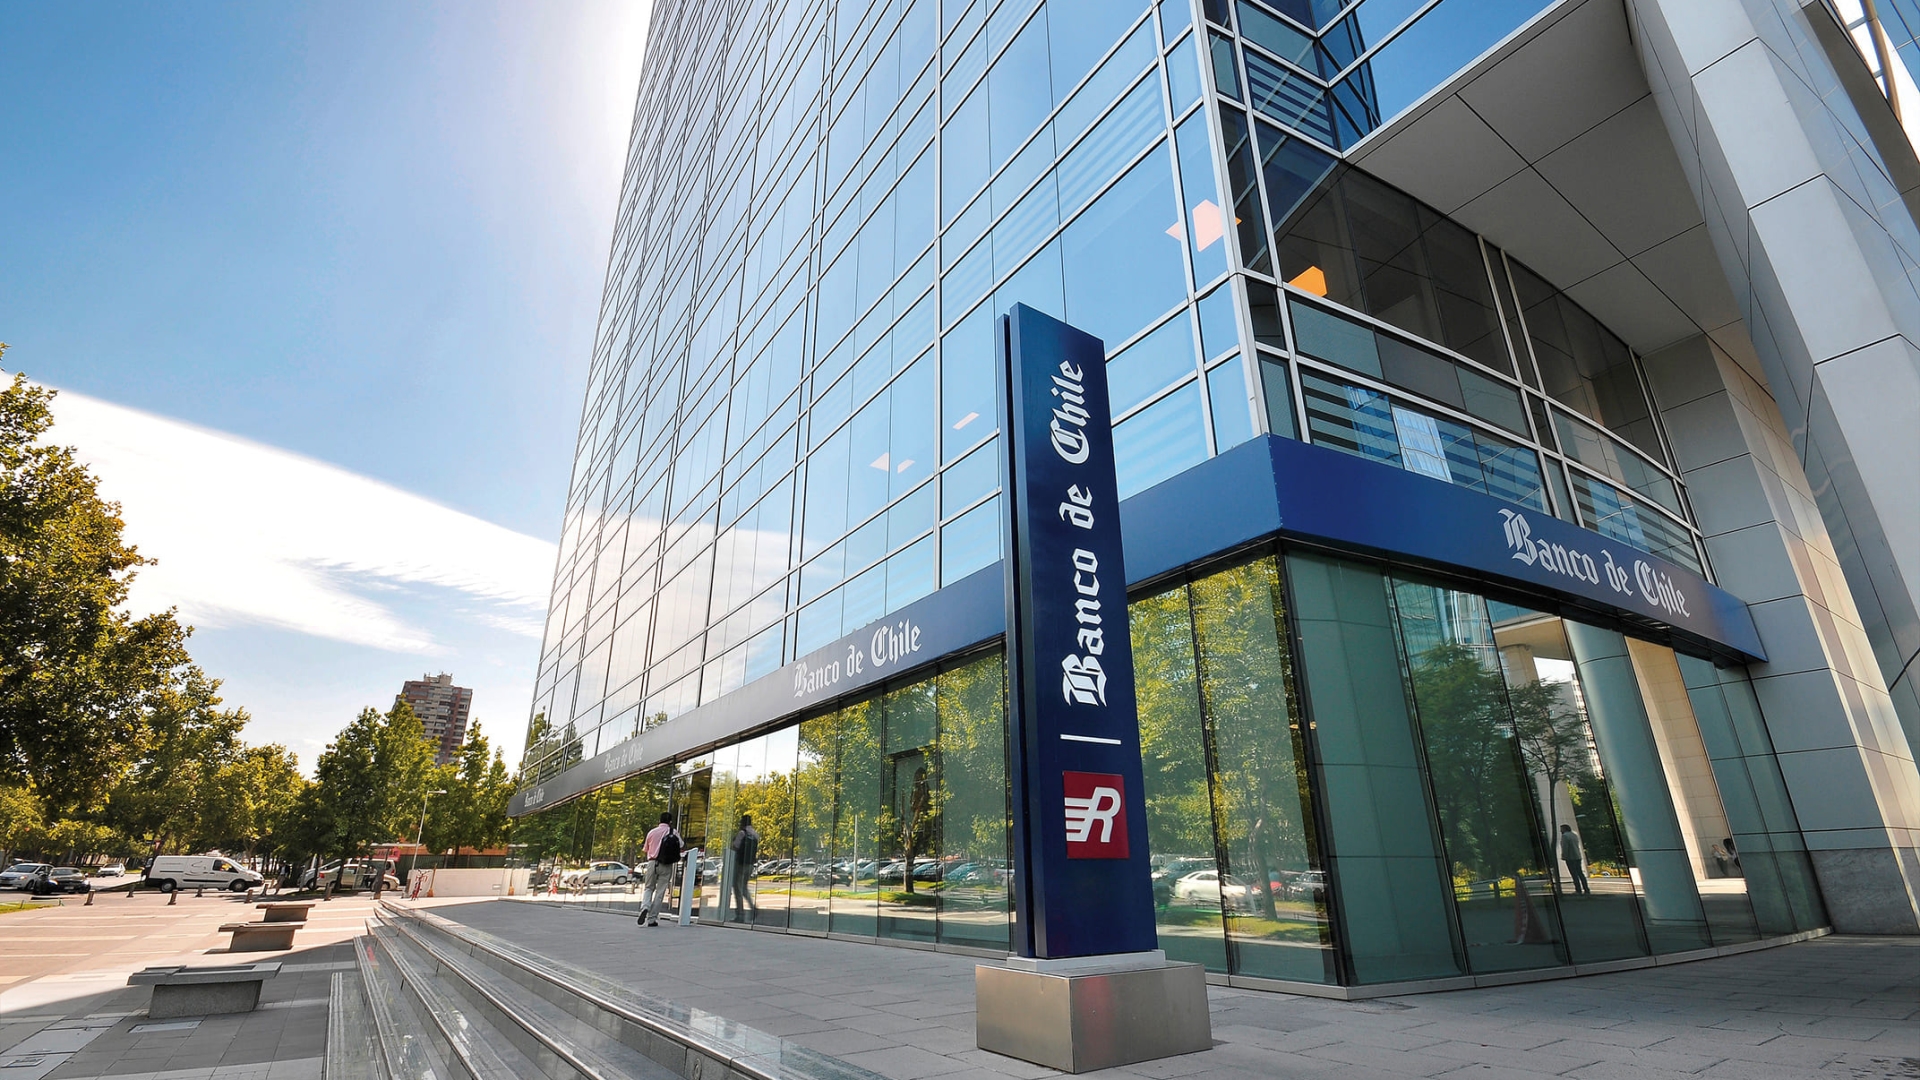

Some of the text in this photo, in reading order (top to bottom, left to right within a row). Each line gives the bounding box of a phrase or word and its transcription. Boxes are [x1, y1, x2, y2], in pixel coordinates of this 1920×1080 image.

[1050, 360, 1107, 707] Banco de Chile
[1498, 508, 1691, 618] Banco de Chile
[794, 618, 921, 698] Banco de Chile
